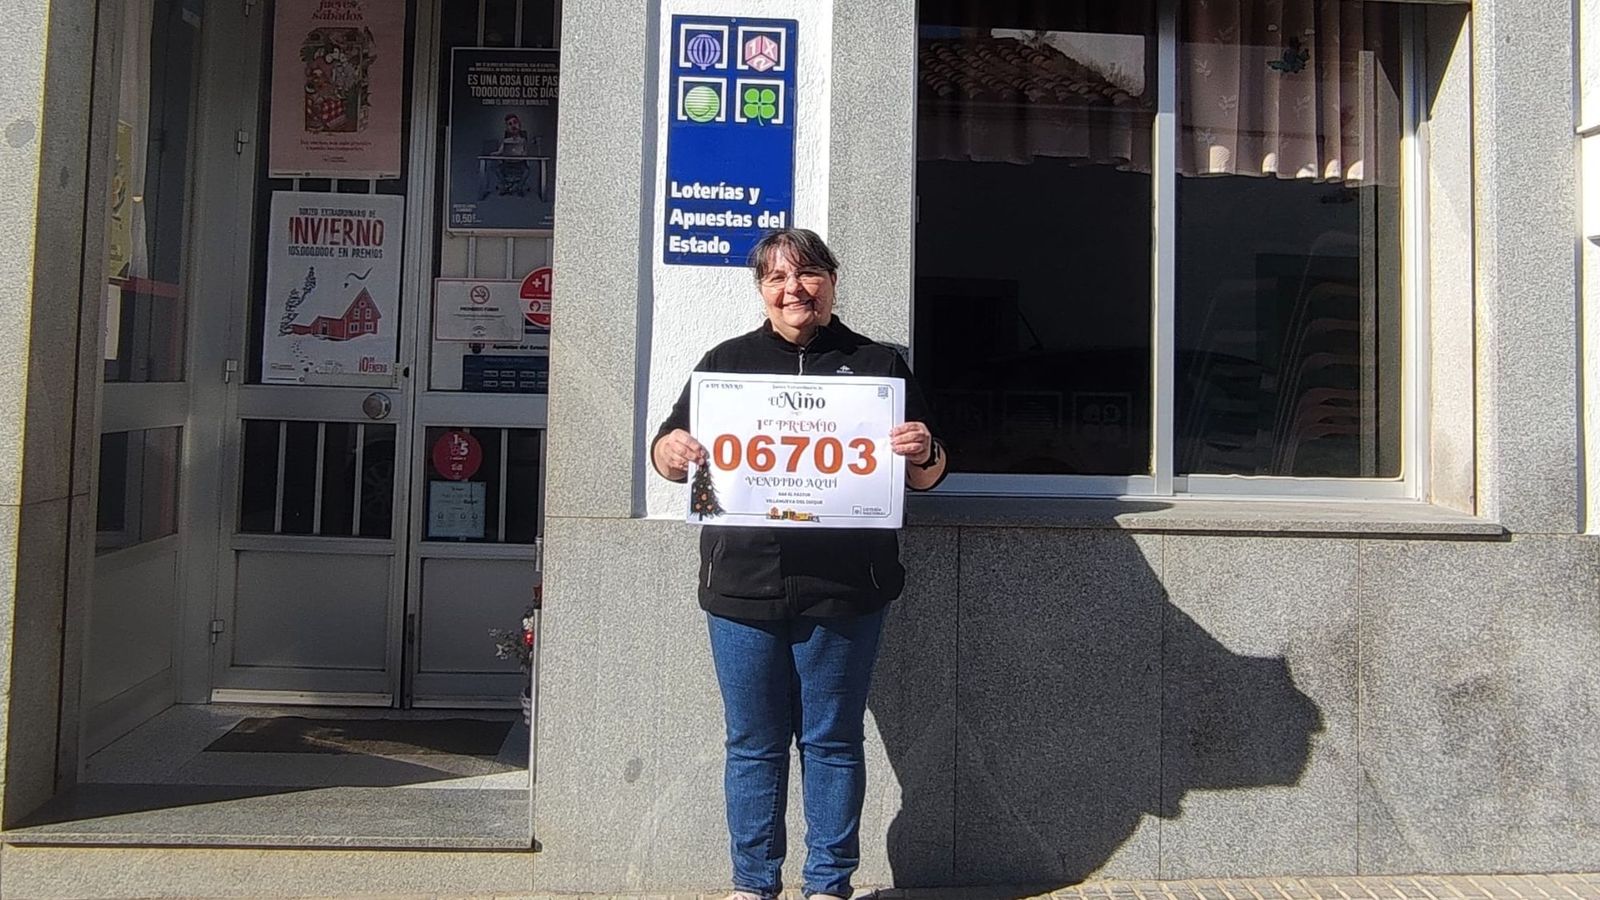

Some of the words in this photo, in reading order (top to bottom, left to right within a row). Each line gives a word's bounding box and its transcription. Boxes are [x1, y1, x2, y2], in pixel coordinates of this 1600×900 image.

[467, 74, 479, 85] ES
[480, 74, 498, 86] UNA
[499, 75, 522, 87] COSA
[523, 75, 541, 87] QUE
[542, 76, 559, 87] PAS
[522, 87, 539, 98] LOS
[671, 181, 744, 200] Loterías
[748, 187, 760, 205] y
[299, 207, 319, 216] SORTEO
[321, 208, 367, 217] EXTRAORDINARIO
[368, 210, 377, 218] DE
[669, 208, 753, 230] Apuestas
[757, 210, 786, 229] del
[288, 216, 385, 247] INVIERNO
[668, 235, 731, 254] Estado
[338, 247, 349, 258] EN
[352, 248, 383, 259] PREMIOS
[359, 356, 369, 372] 10
[768, 395, 780, 406] El
[778, 391, 826, 410] Niño
[757, 419, 774, 430] 1er
[776, 419, 837, 433] PREMIO
[713, 433, 878, 475] 06703
[745, 476, 803, 488] VENDIDO
[804, 477, 838, 490] AQUÍ
